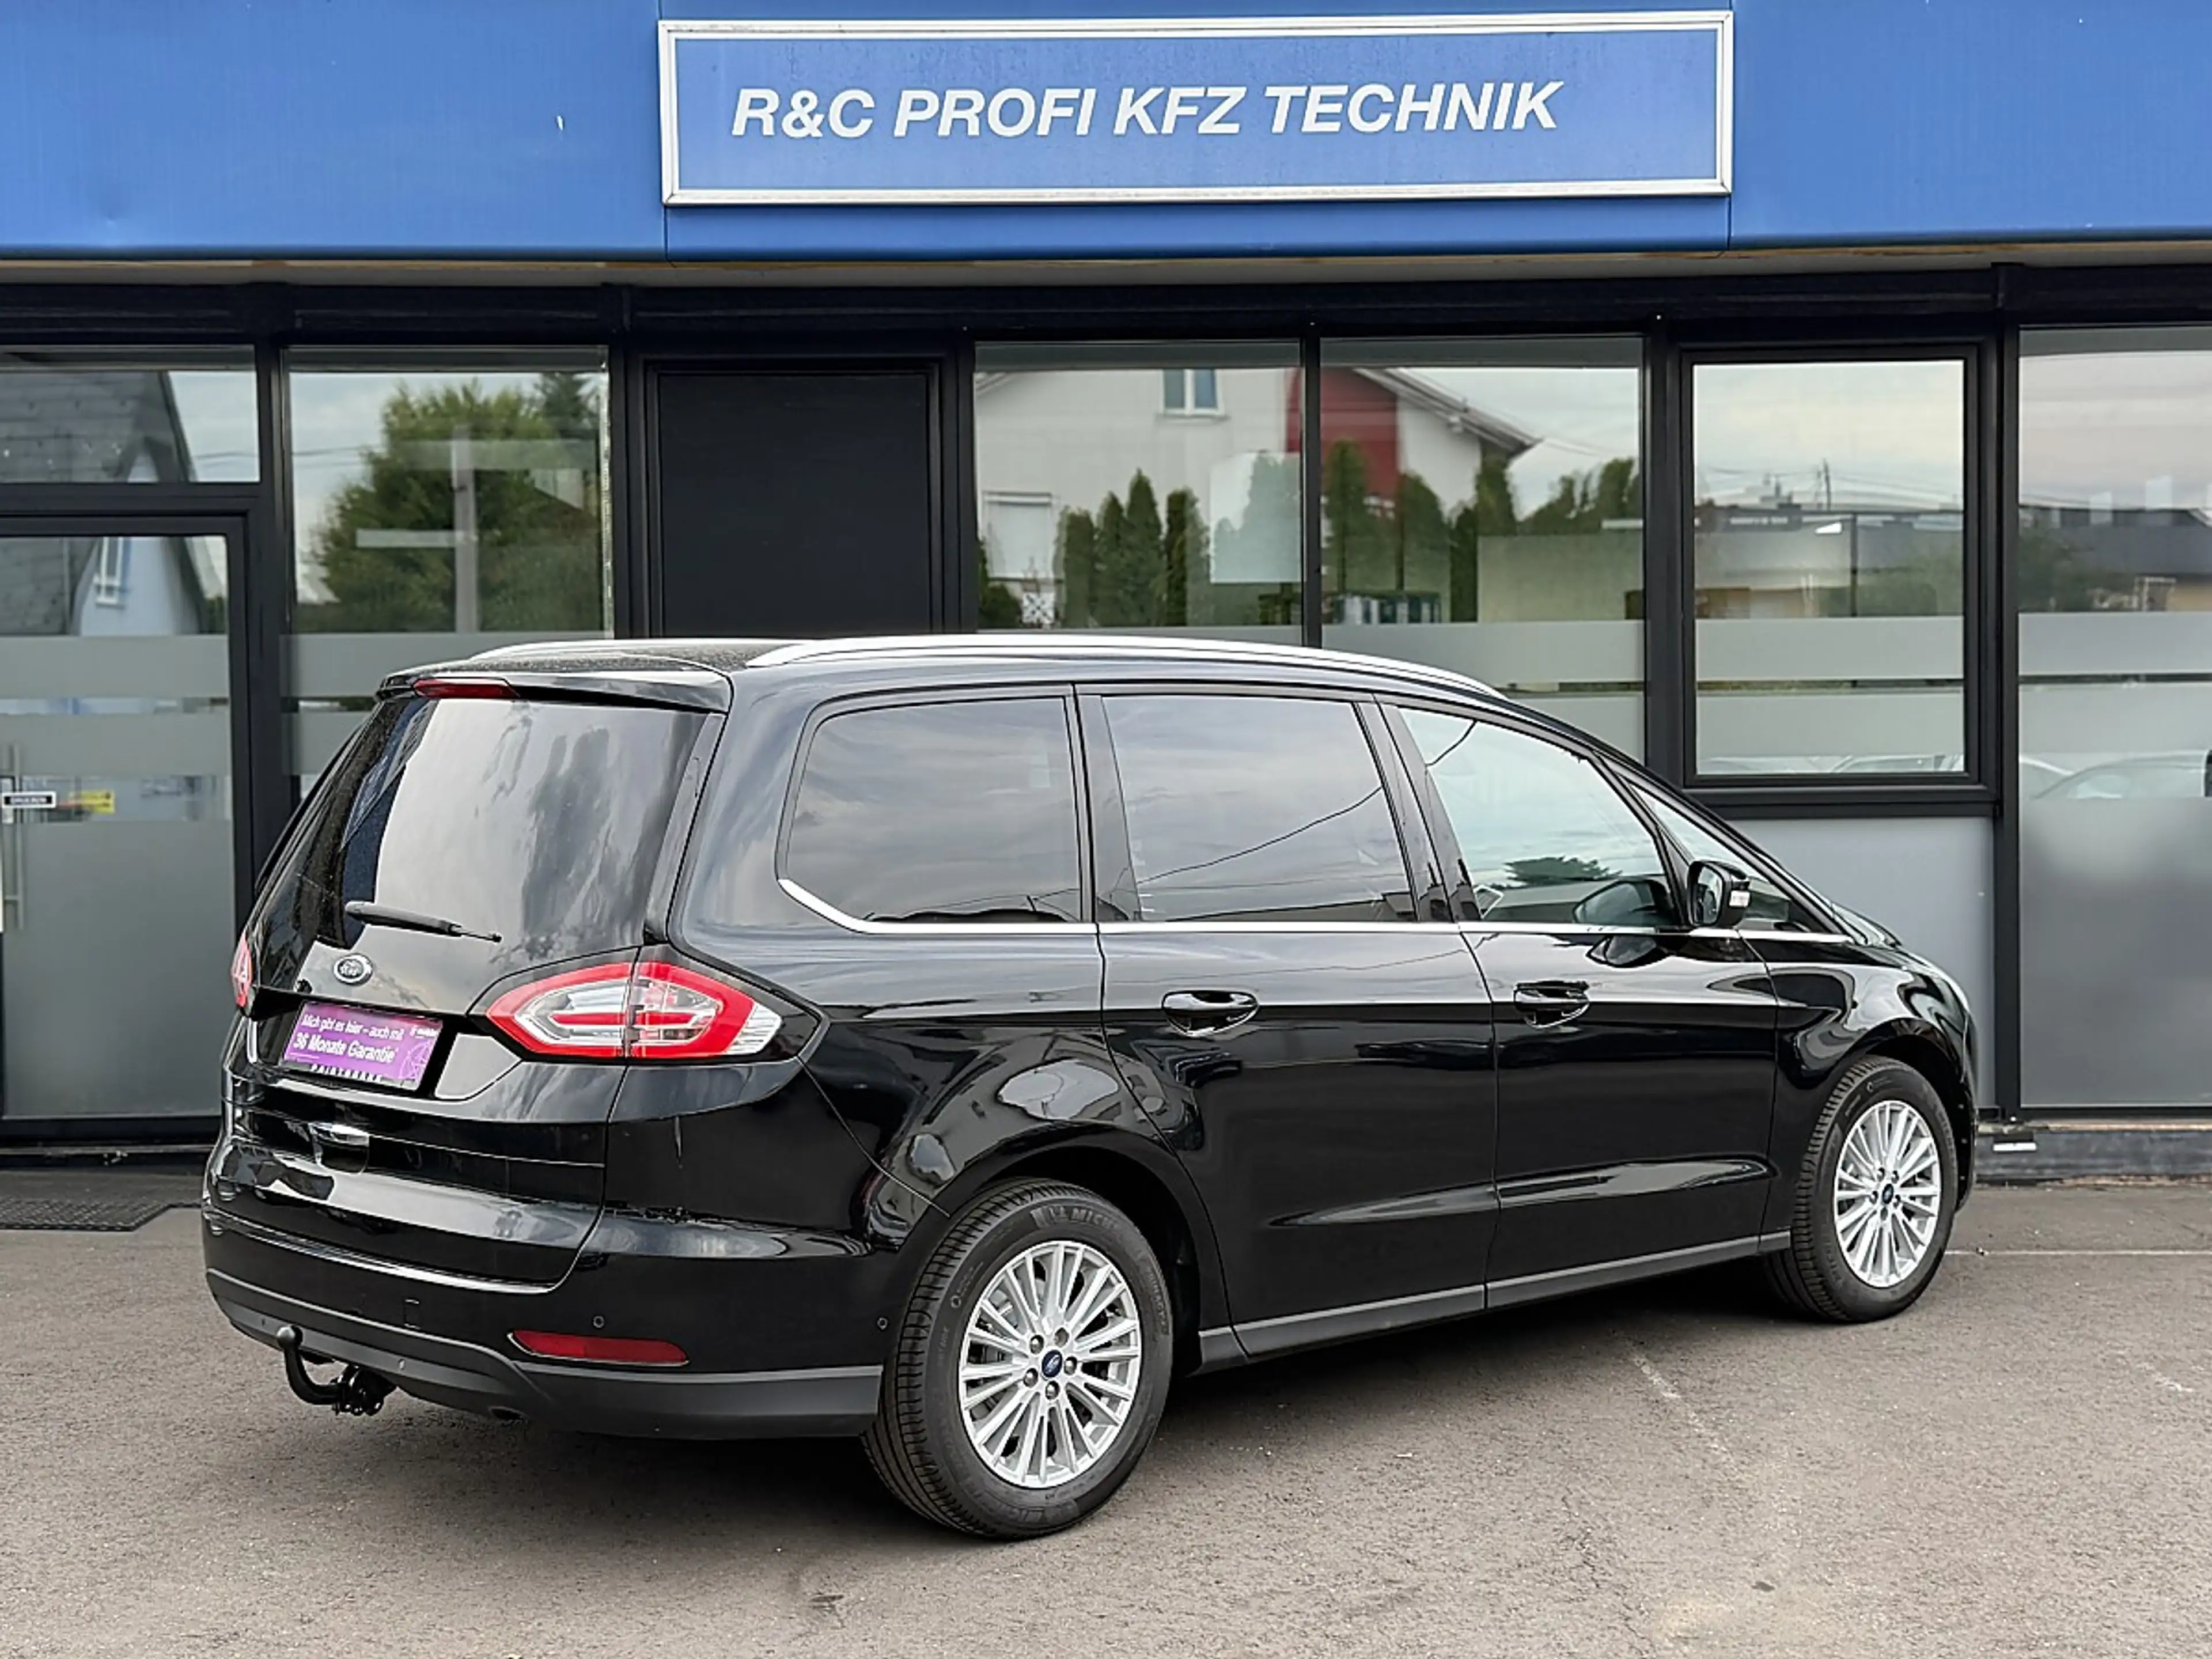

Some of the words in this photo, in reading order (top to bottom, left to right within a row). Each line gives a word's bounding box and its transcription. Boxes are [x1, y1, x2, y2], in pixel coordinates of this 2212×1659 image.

[731, 88, 876, 138] R&C
[893, 88, 1096, 138] PROFI
[1112, 85, 1248, 136] KFZ
[1264, 80, 1565, 134] TECHNIK
[308, 1034, 347, 1055] Monate
